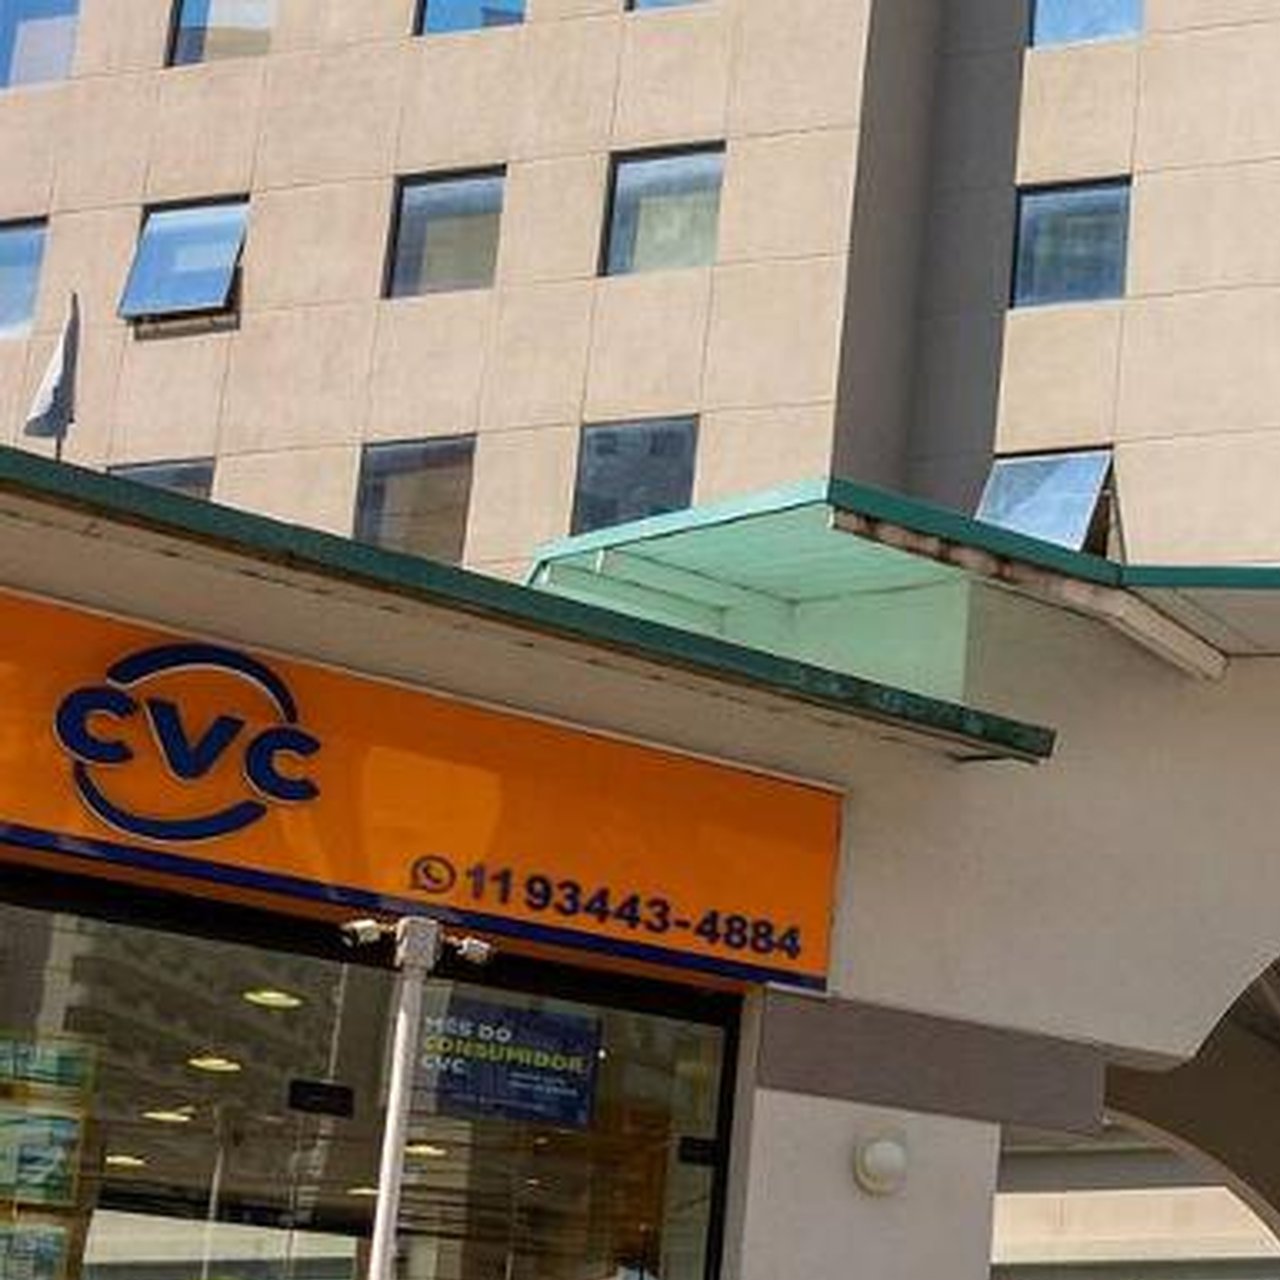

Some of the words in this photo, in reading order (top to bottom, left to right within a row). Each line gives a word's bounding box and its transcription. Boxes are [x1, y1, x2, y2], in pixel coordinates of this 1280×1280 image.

[55, 684, 322, 801] CVC
[466, 862, 514, 905] 11
[524, 874, 802, 960] 93443-4884
[423, 1035, 588, 1071] CONSUMIDOR
[477, 1022, 512, 1043] DO
